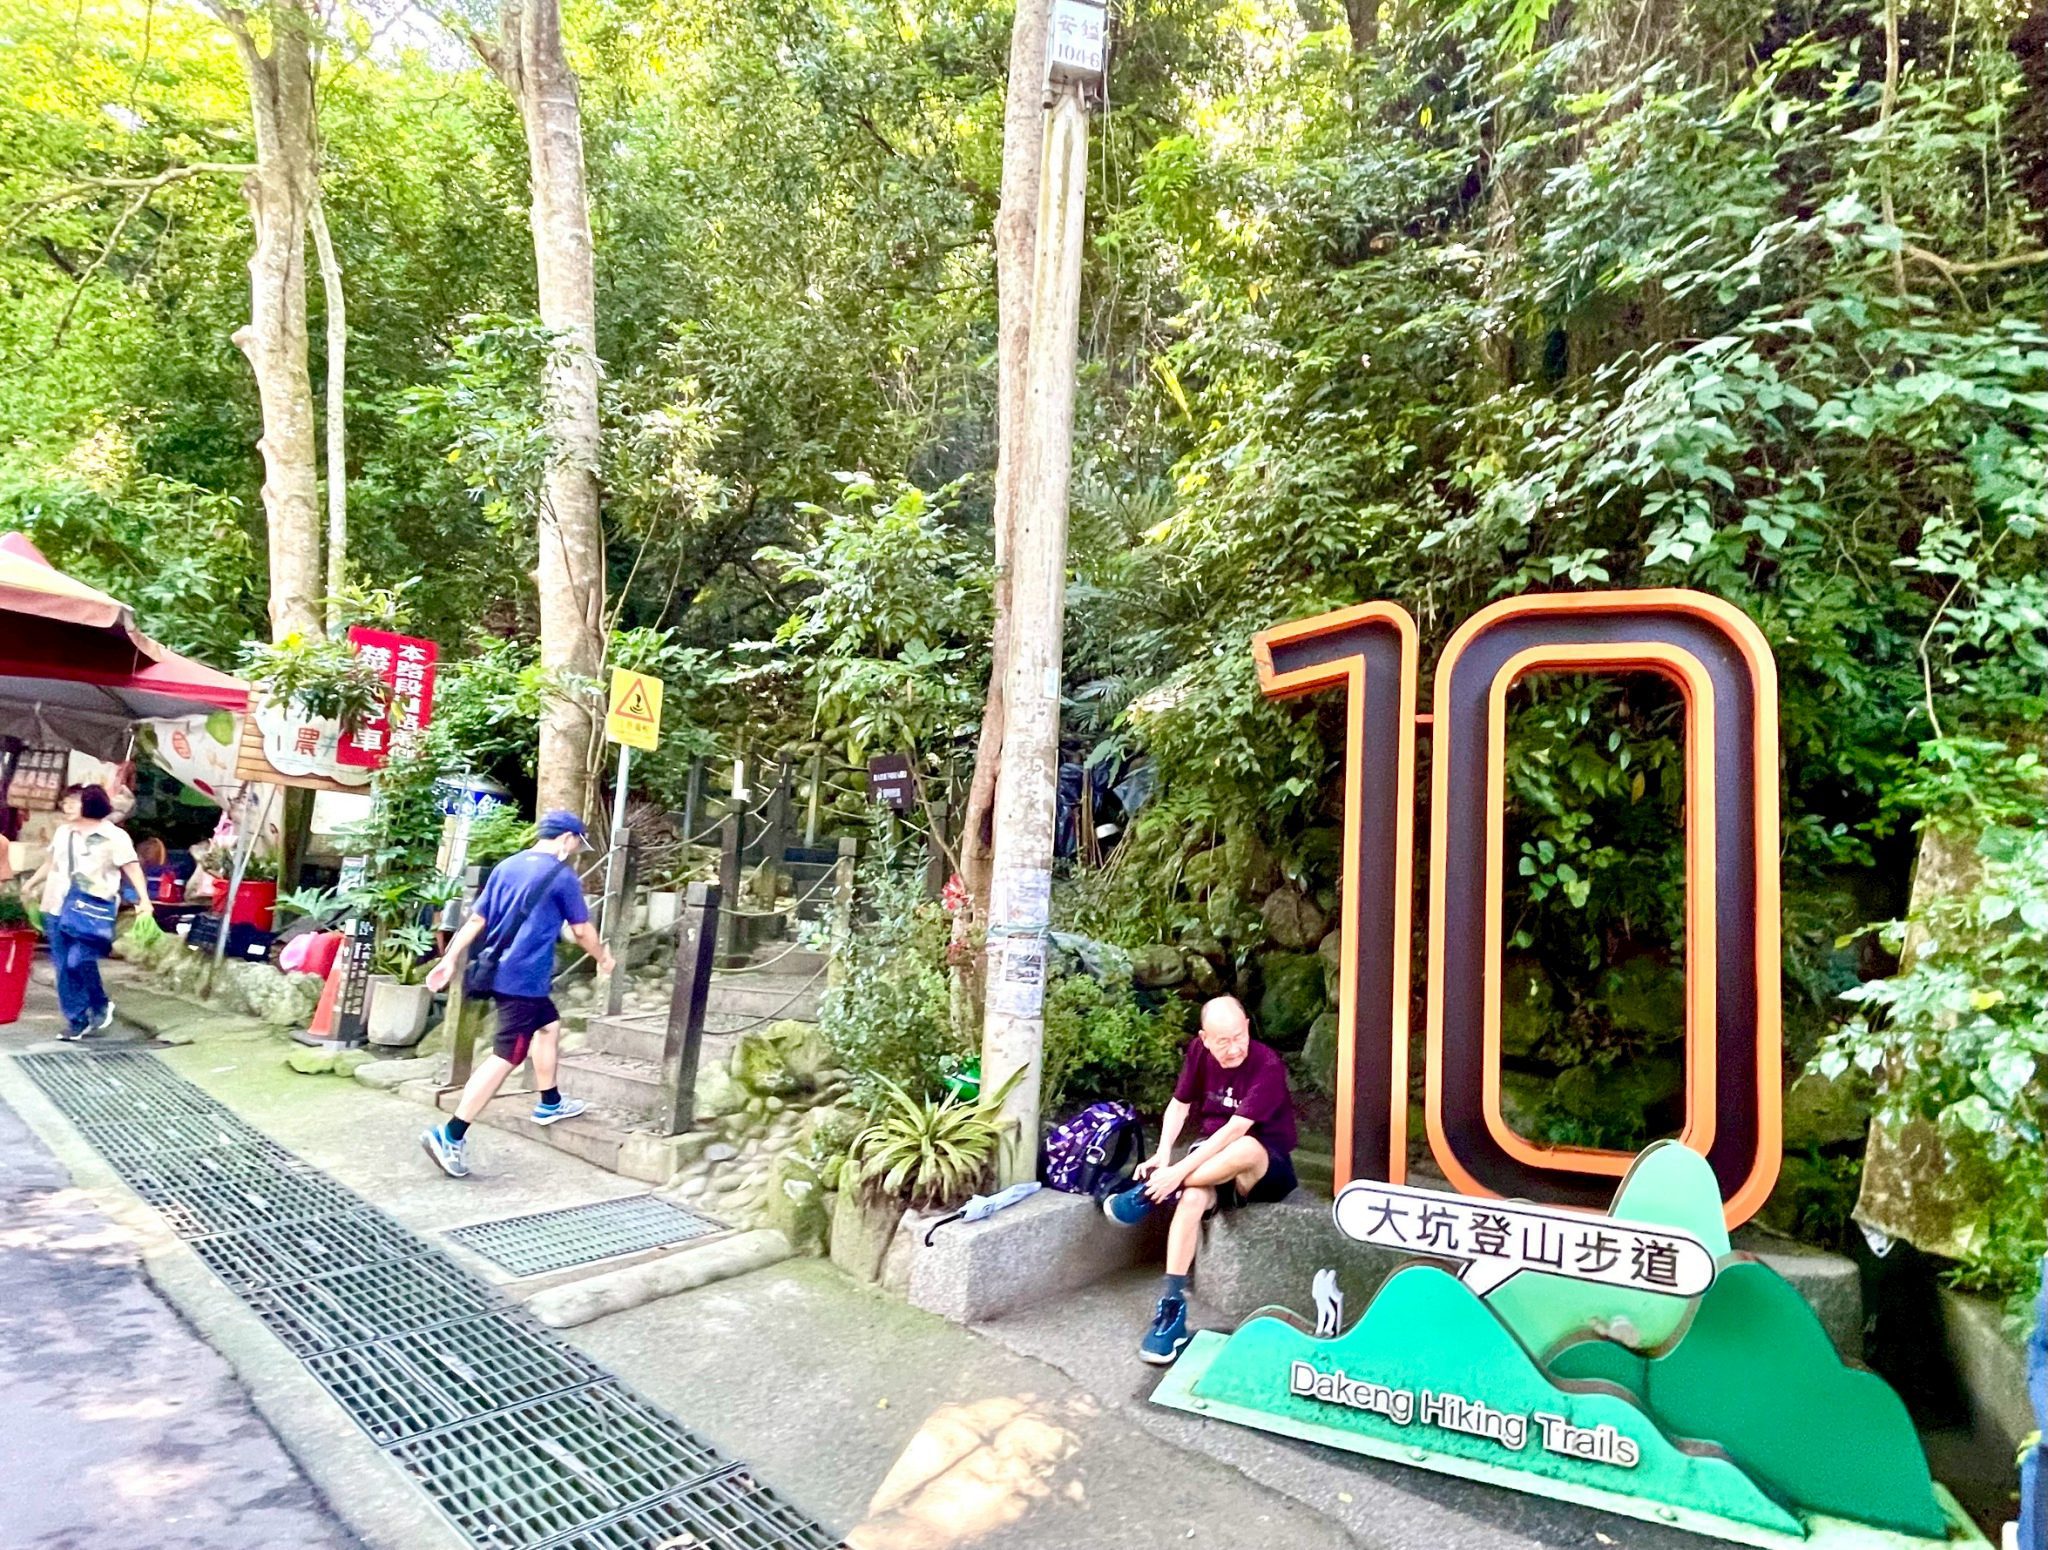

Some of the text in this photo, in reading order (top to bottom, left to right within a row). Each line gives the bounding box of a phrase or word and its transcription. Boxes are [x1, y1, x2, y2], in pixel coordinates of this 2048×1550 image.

[1058, 43, 1100, 68] 1046
[1254, 588, 1782, 1231] 10
[1366, 1198, 1680, 1287] 大坑登山步道
[1290, 1360, 1640, 1467] Dakeng Hiking Trails
